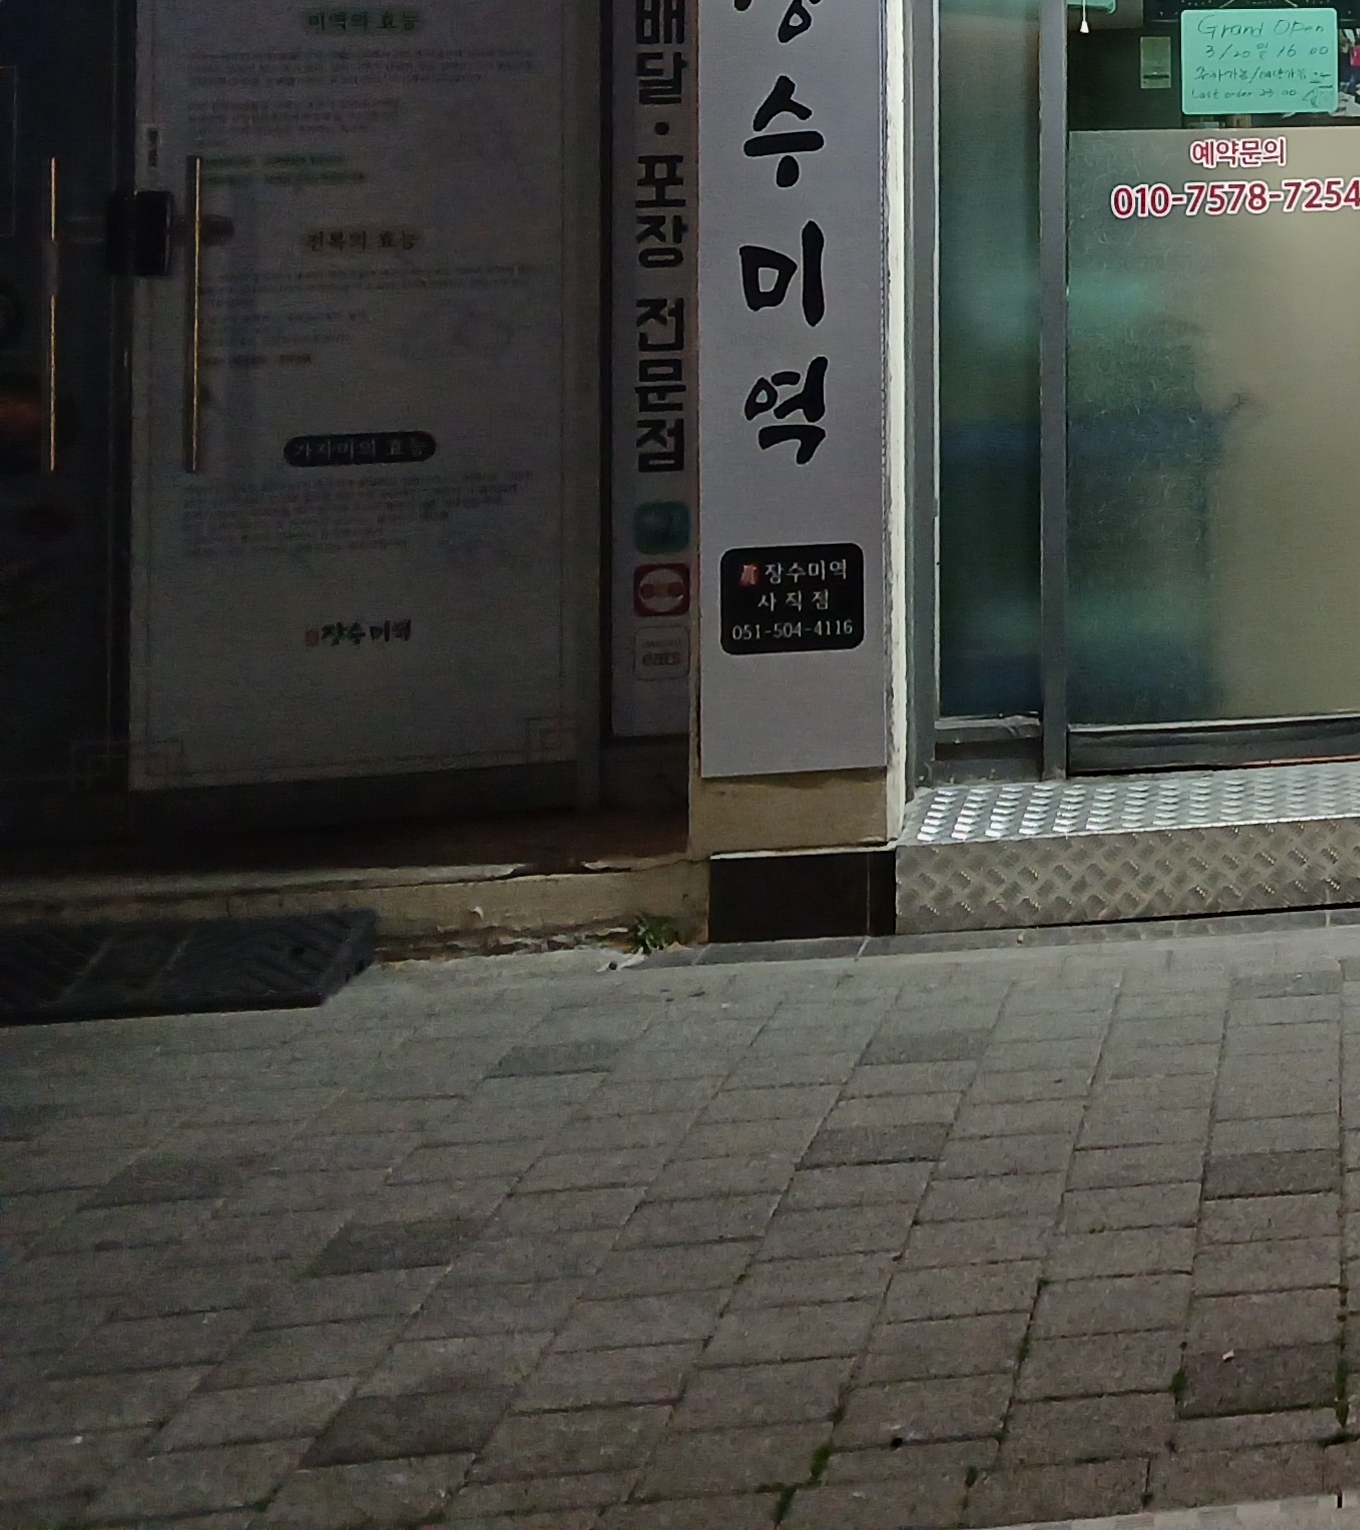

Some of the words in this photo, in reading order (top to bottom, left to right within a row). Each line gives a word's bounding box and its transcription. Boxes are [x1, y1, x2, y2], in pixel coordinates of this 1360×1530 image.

[1198, 15, 1264, 39] Grand
[1190, 137, 1286, 168] 예약문의
[635, 298, 687, 471] 전문점
[764, 558, 849, 586] 장수미역
[732, 618, 853, 641] 051-504-4116
